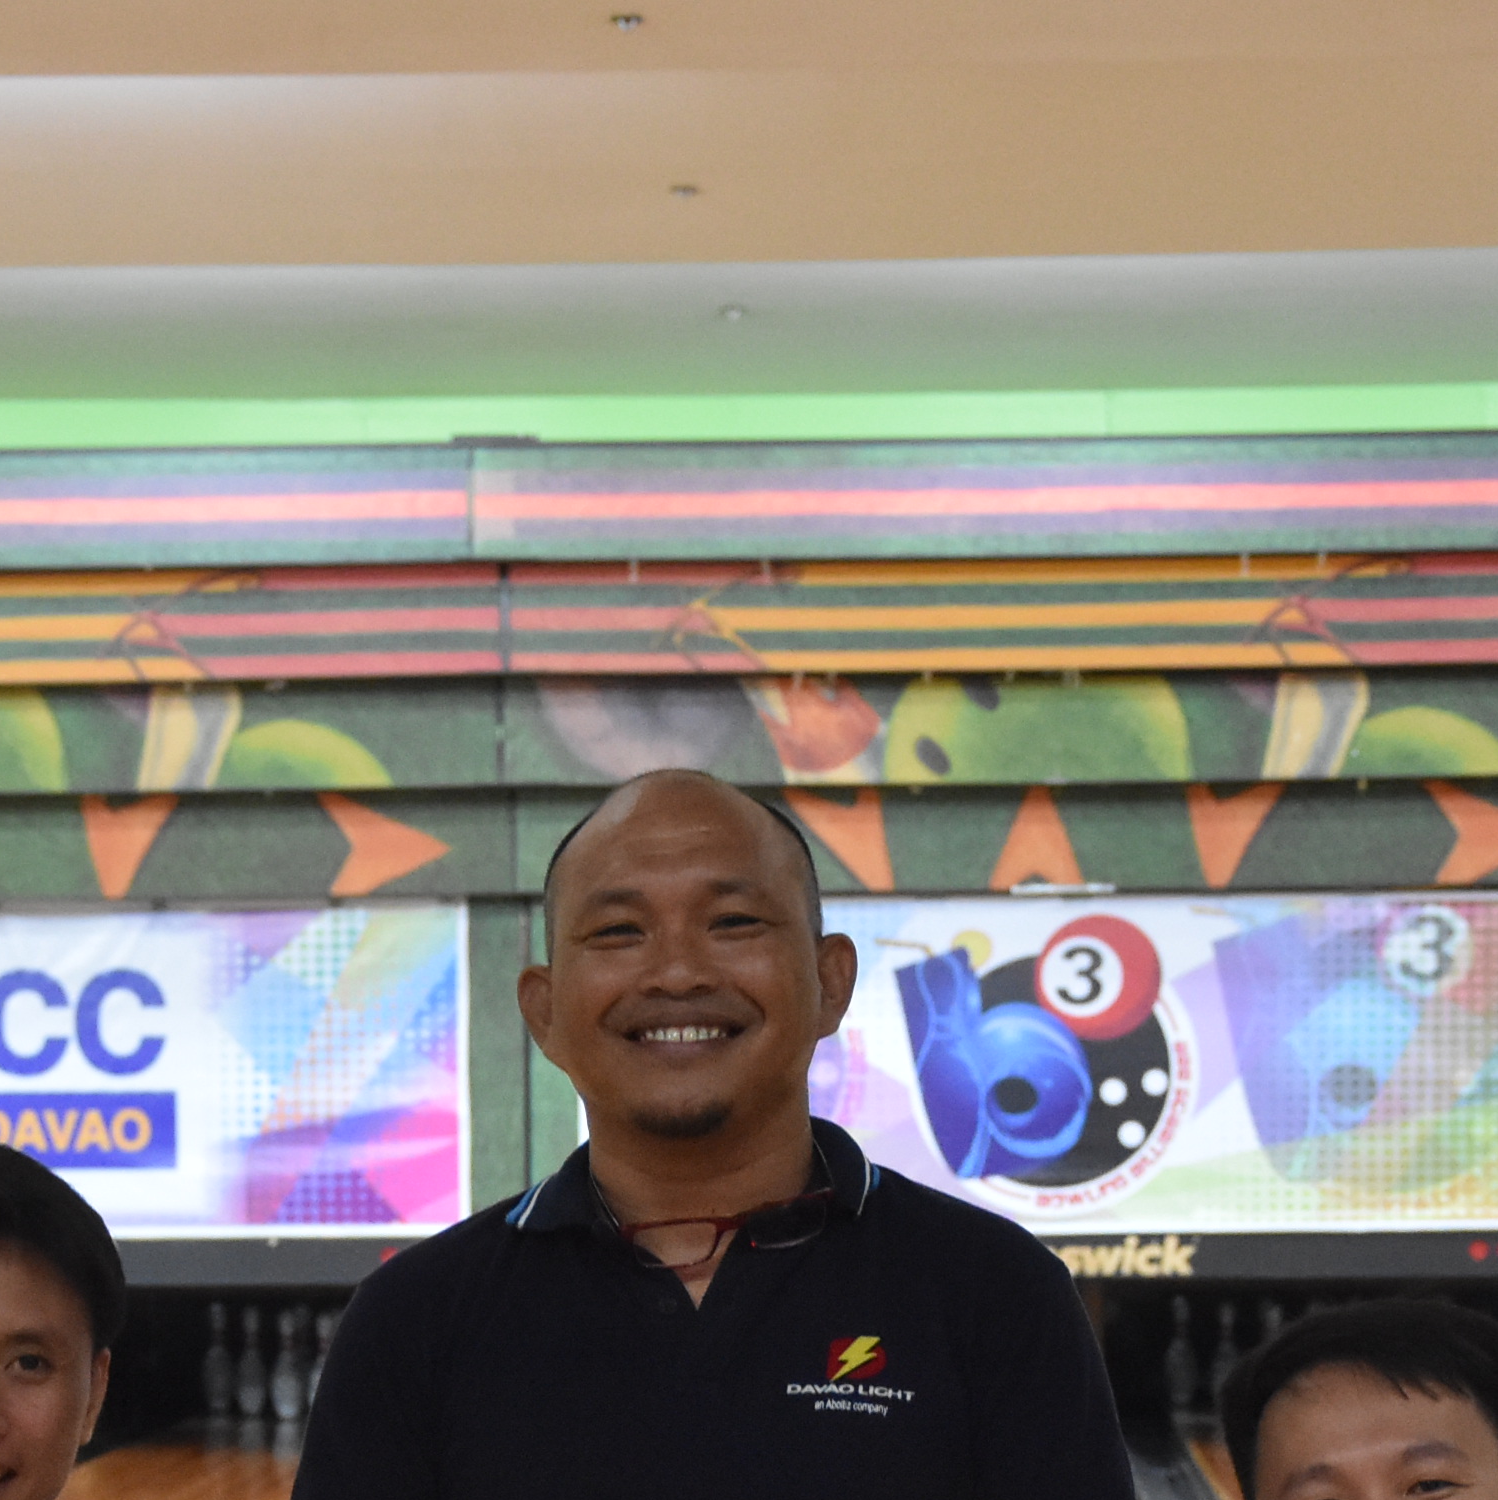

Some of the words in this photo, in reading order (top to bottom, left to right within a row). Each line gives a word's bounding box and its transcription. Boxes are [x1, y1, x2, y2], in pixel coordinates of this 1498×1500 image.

[1400, 914, 1455, 982] 3
[1055, 946, 1107, 1007] 3
[1051, 1234, 1196, 1278] swick
[786, 1383, 854, 1395] DAVAO
[858, 1385, 915, 1401] LIGHT
[852, 1401, 889, 1417] company
